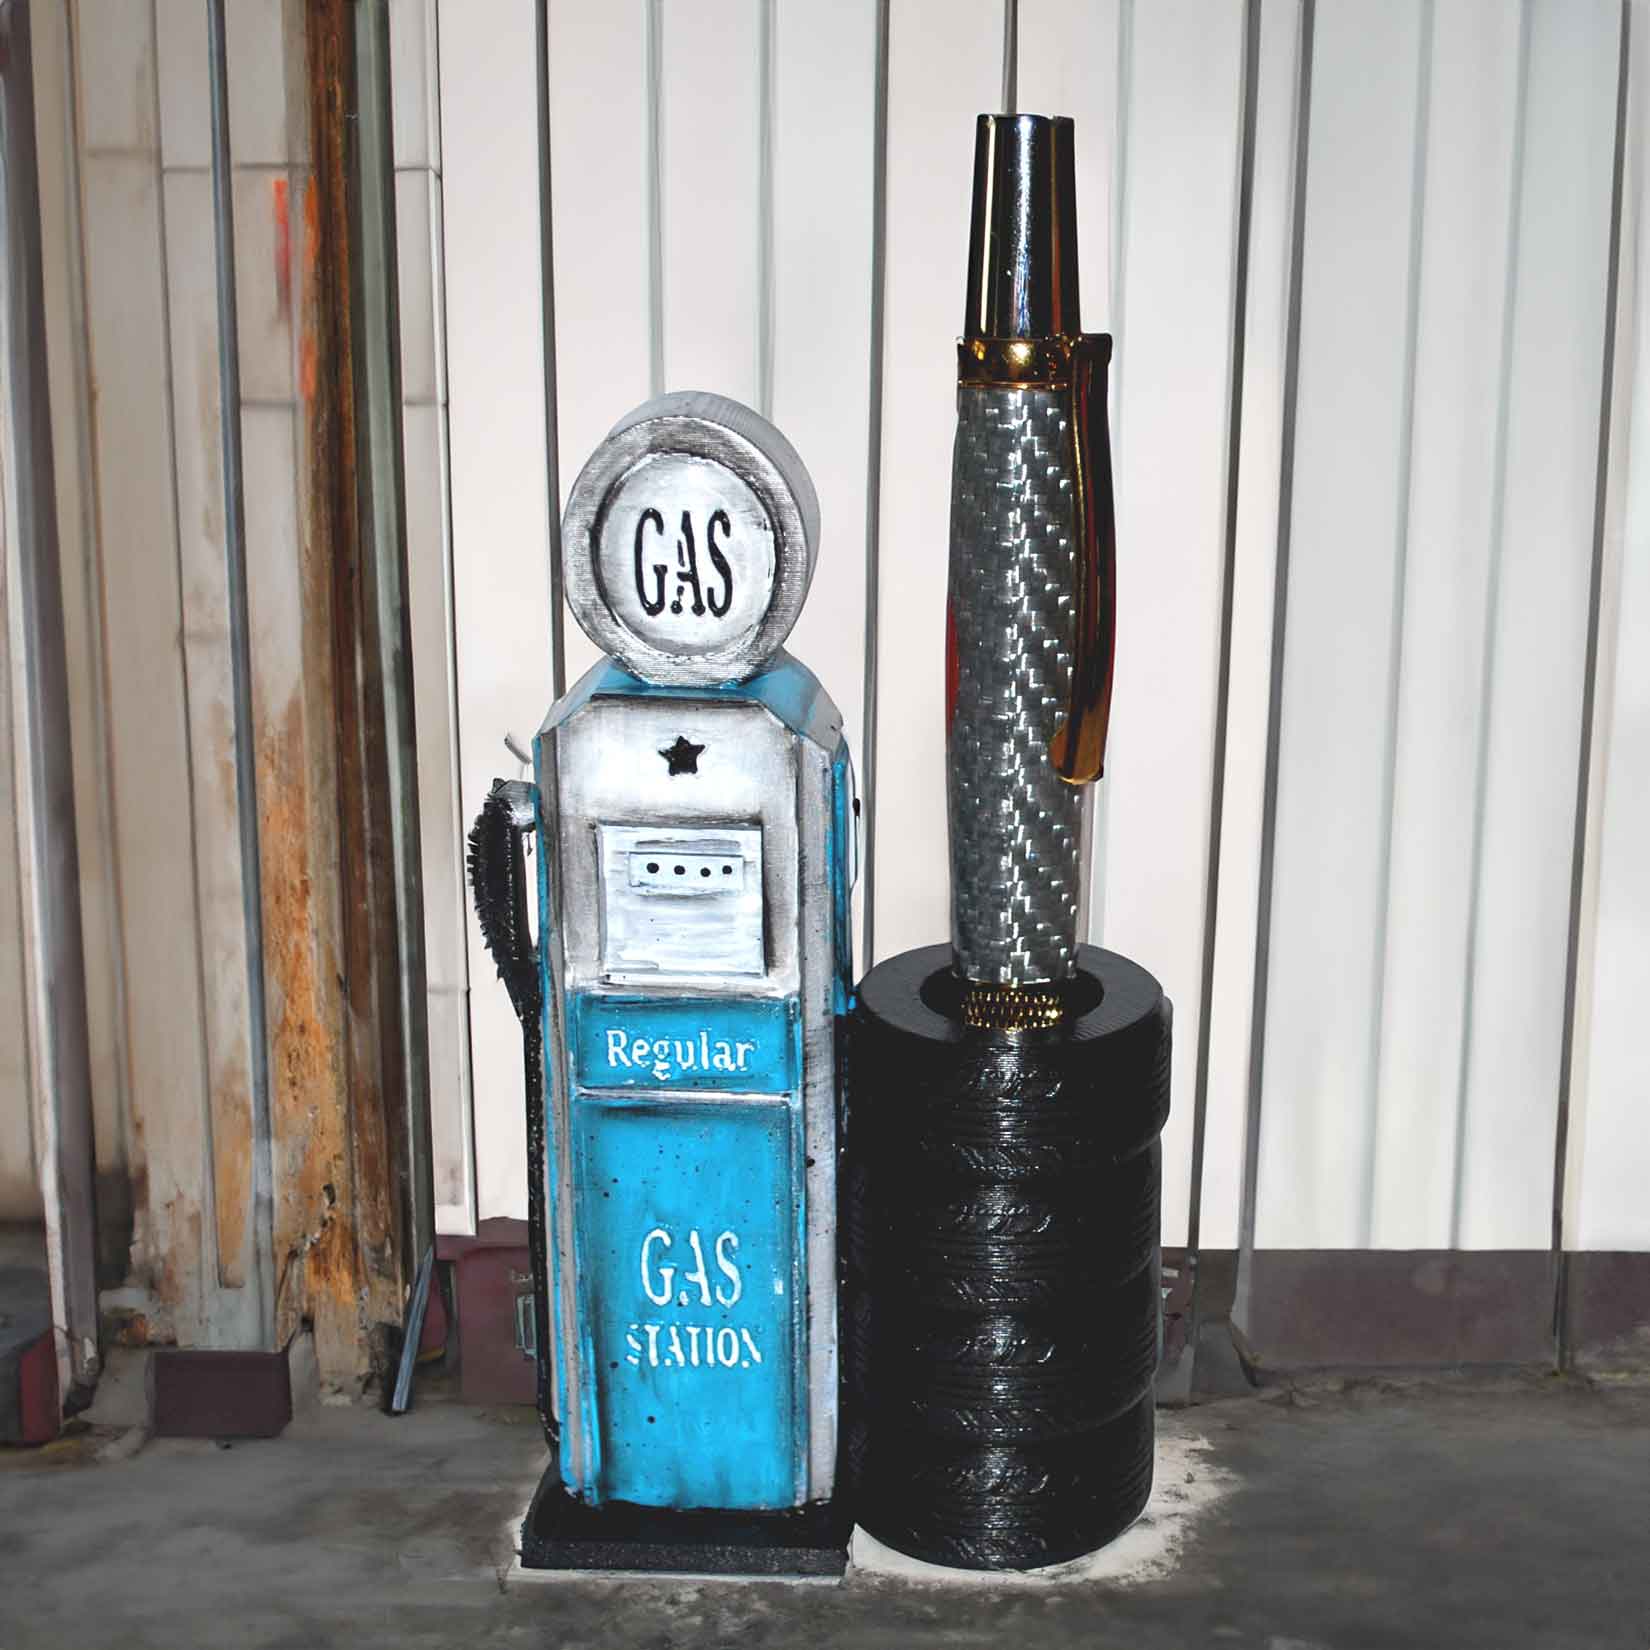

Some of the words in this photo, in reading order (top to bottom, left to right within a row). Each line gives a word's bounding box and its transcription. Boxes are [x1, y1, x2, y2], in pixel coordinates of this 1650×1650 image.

[634, 507, 733, 618] GAS
[606, 1029, 755, 1081] Regular
[640, 1228, 742, 1309] GAS
[625, 1323, 763, 1368] STATION
